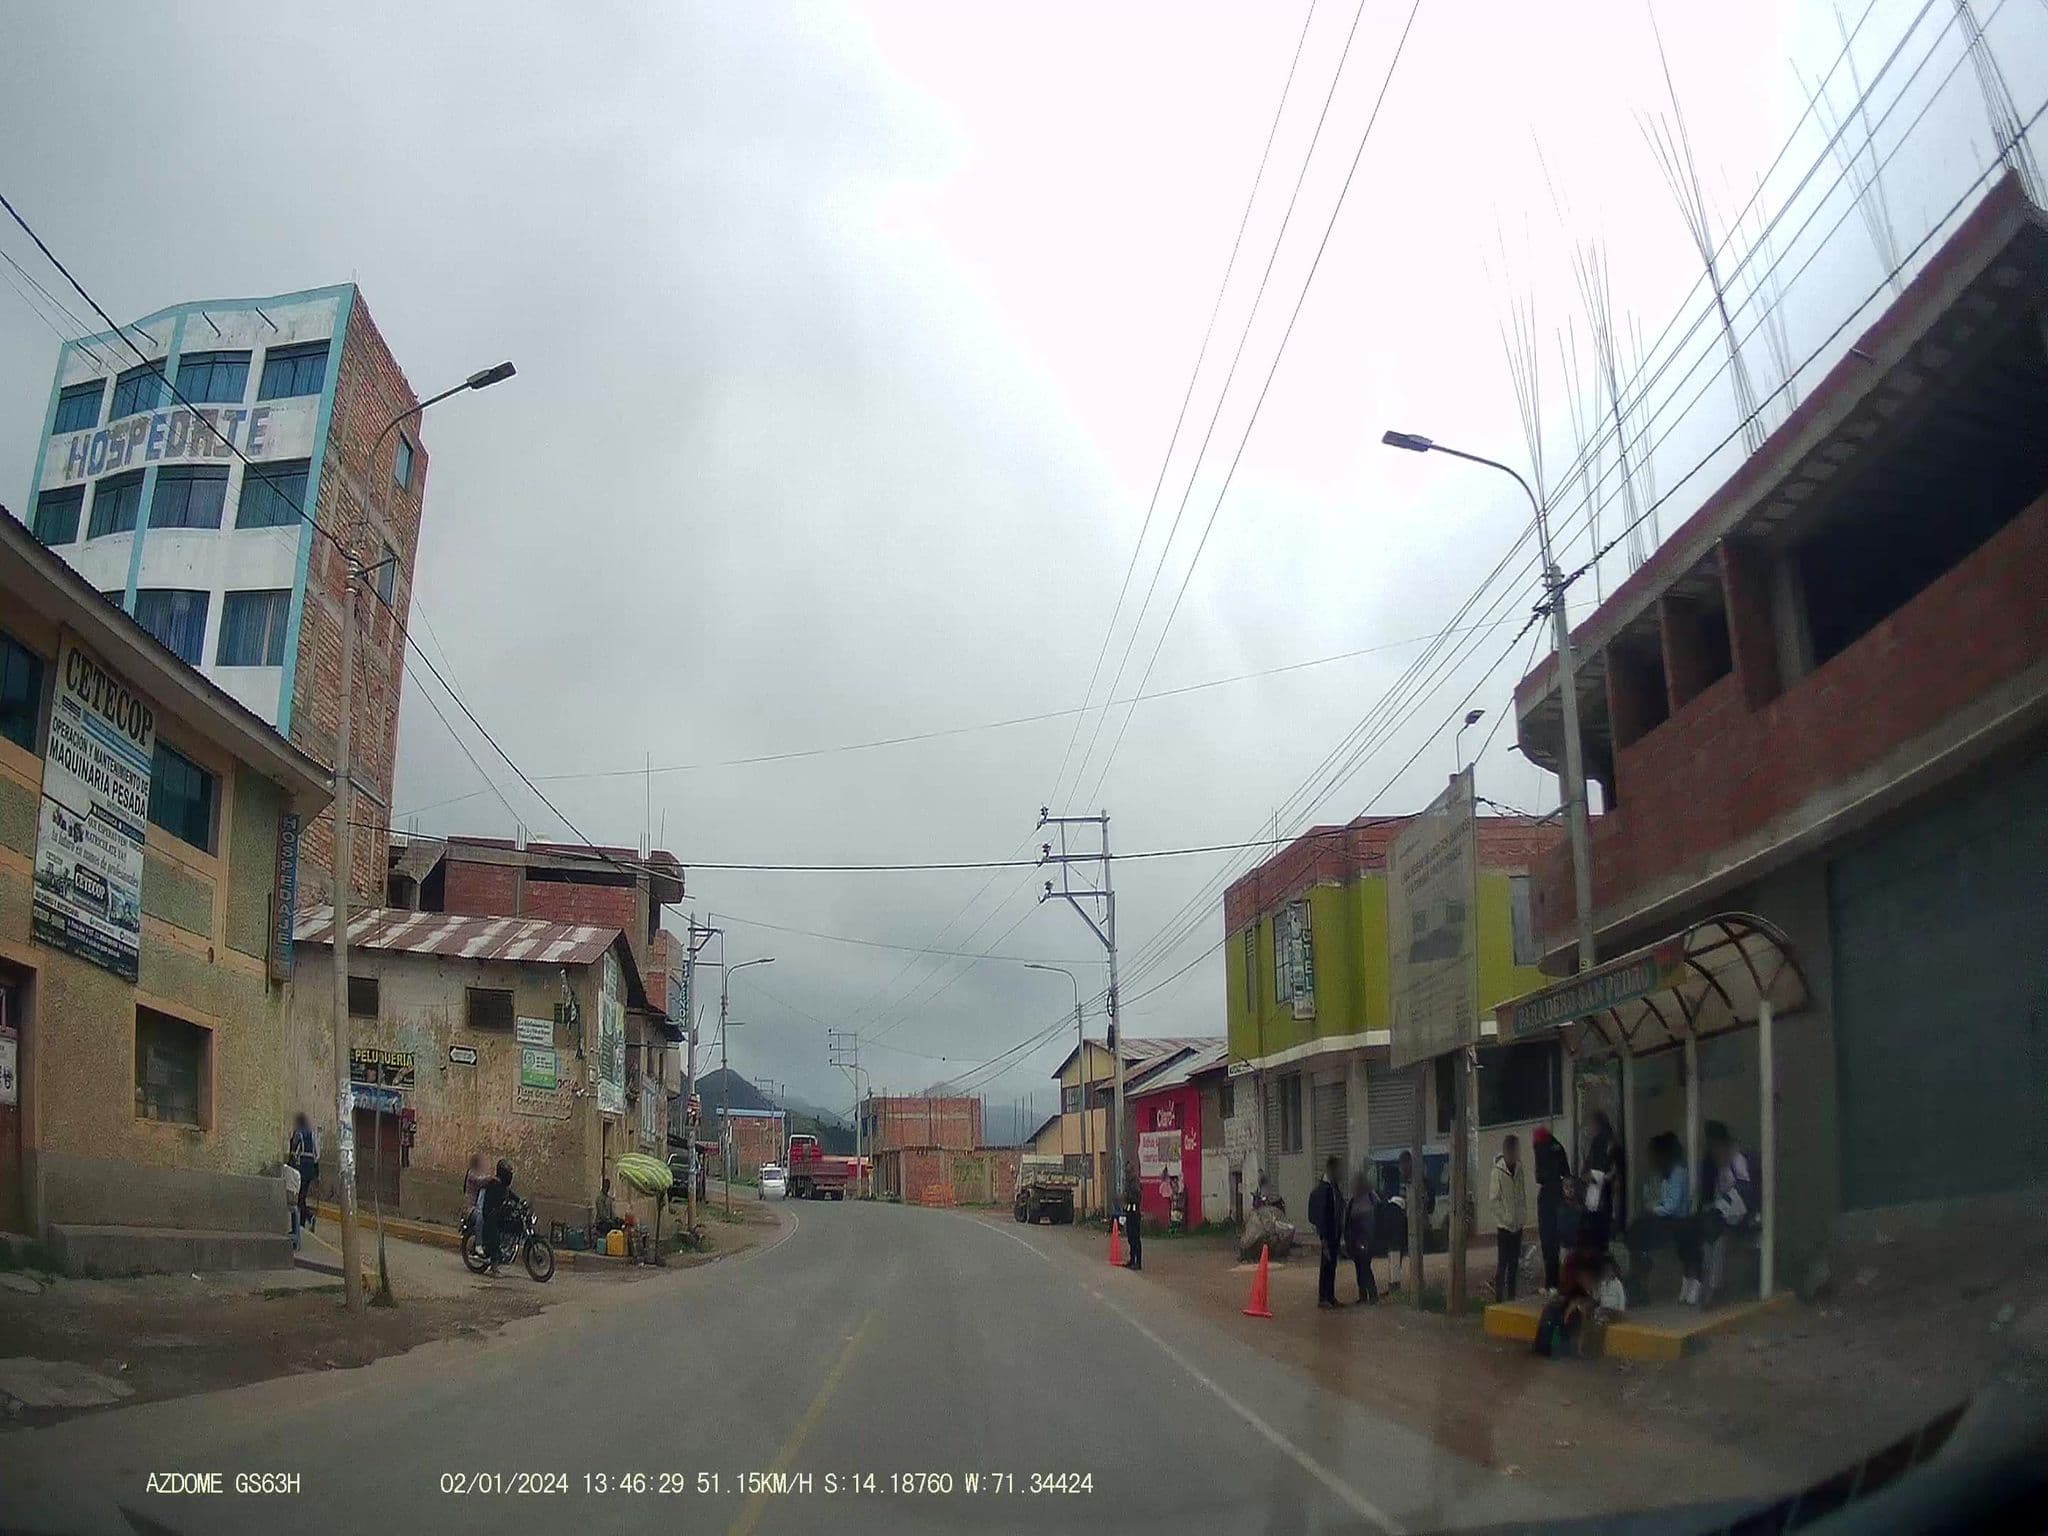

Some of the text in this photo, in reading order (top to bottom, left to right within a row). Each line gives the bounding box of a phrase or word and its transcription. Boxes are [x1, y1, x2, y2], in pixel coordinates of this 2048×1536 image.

[65, 647, 154, 746] CETECOP
[49, 735, 110, 795] MAQUINARIA
[111, 778, 146, 820] PESADA
